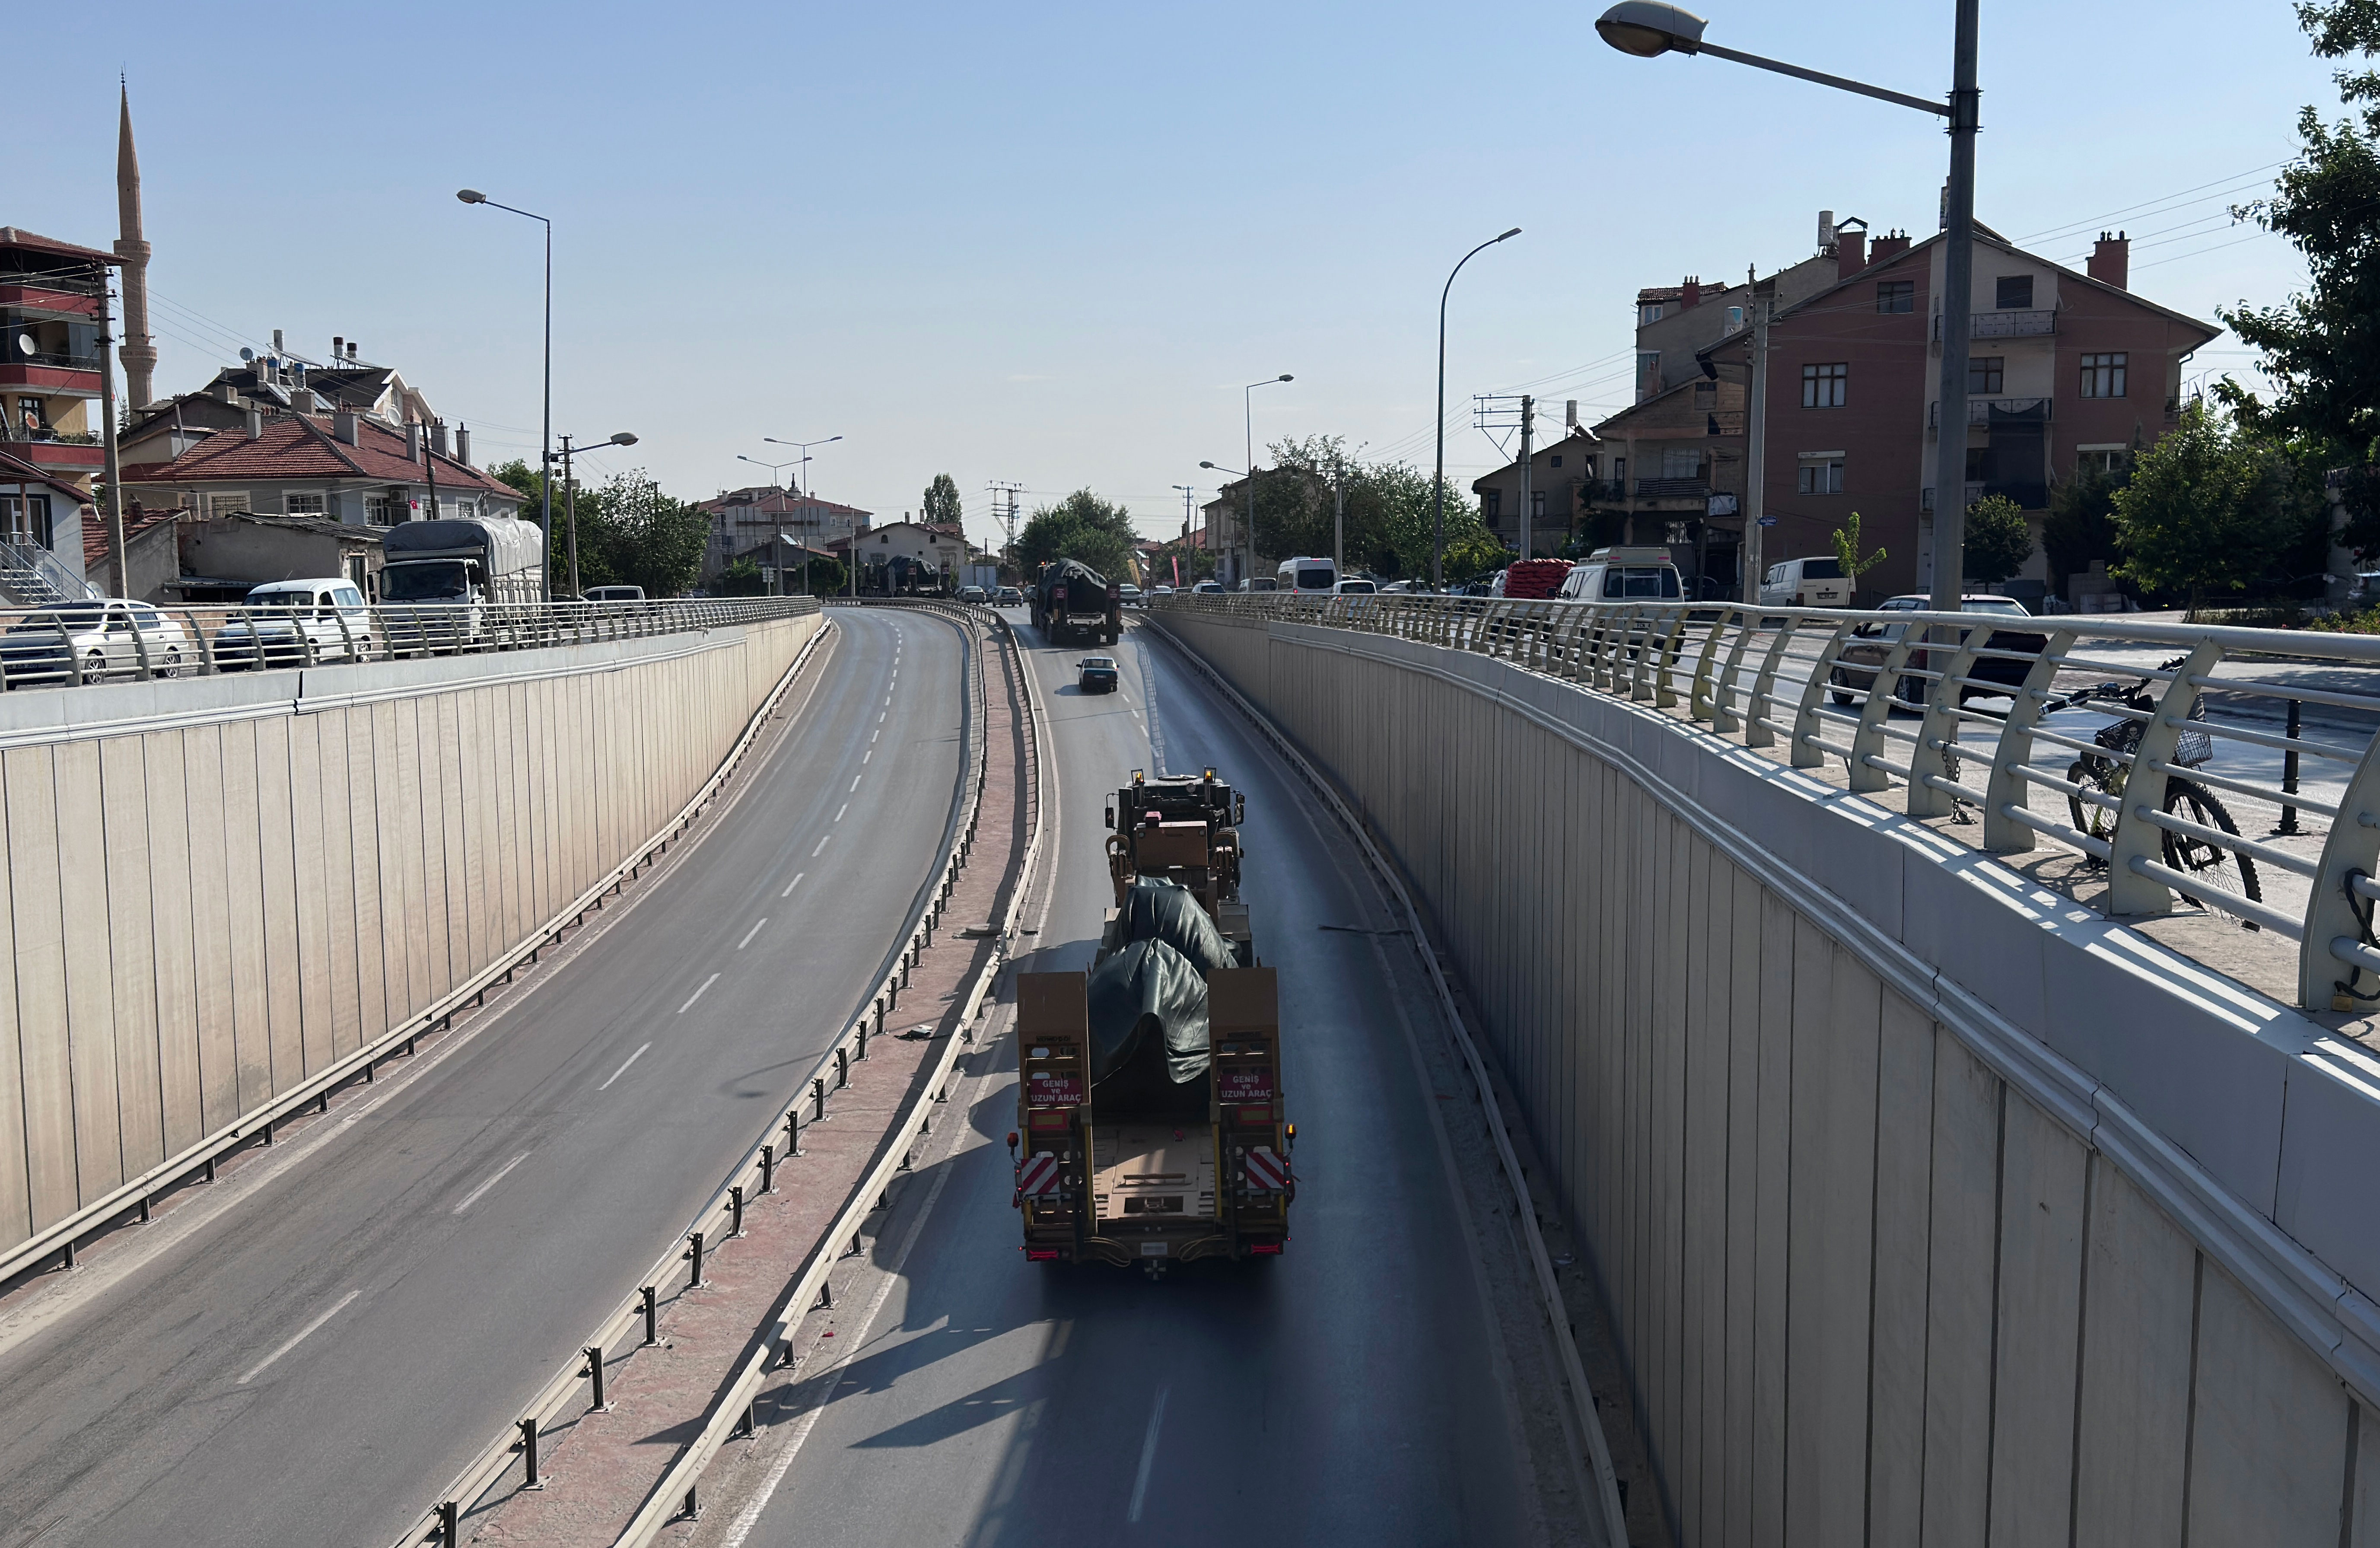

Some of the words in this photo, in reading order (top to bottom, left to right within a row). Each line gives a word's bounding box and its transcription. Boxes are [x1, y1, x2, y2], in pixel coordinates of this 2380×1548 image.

[1042, 1077, 1069, 1089] GENİŞ
[1233, 1073, 1259, 1084] GENİŞ
[1058, 1094, 1082, 1103] ARAÇ
[1248, 1089, 1272, 1099] ARAÇ
